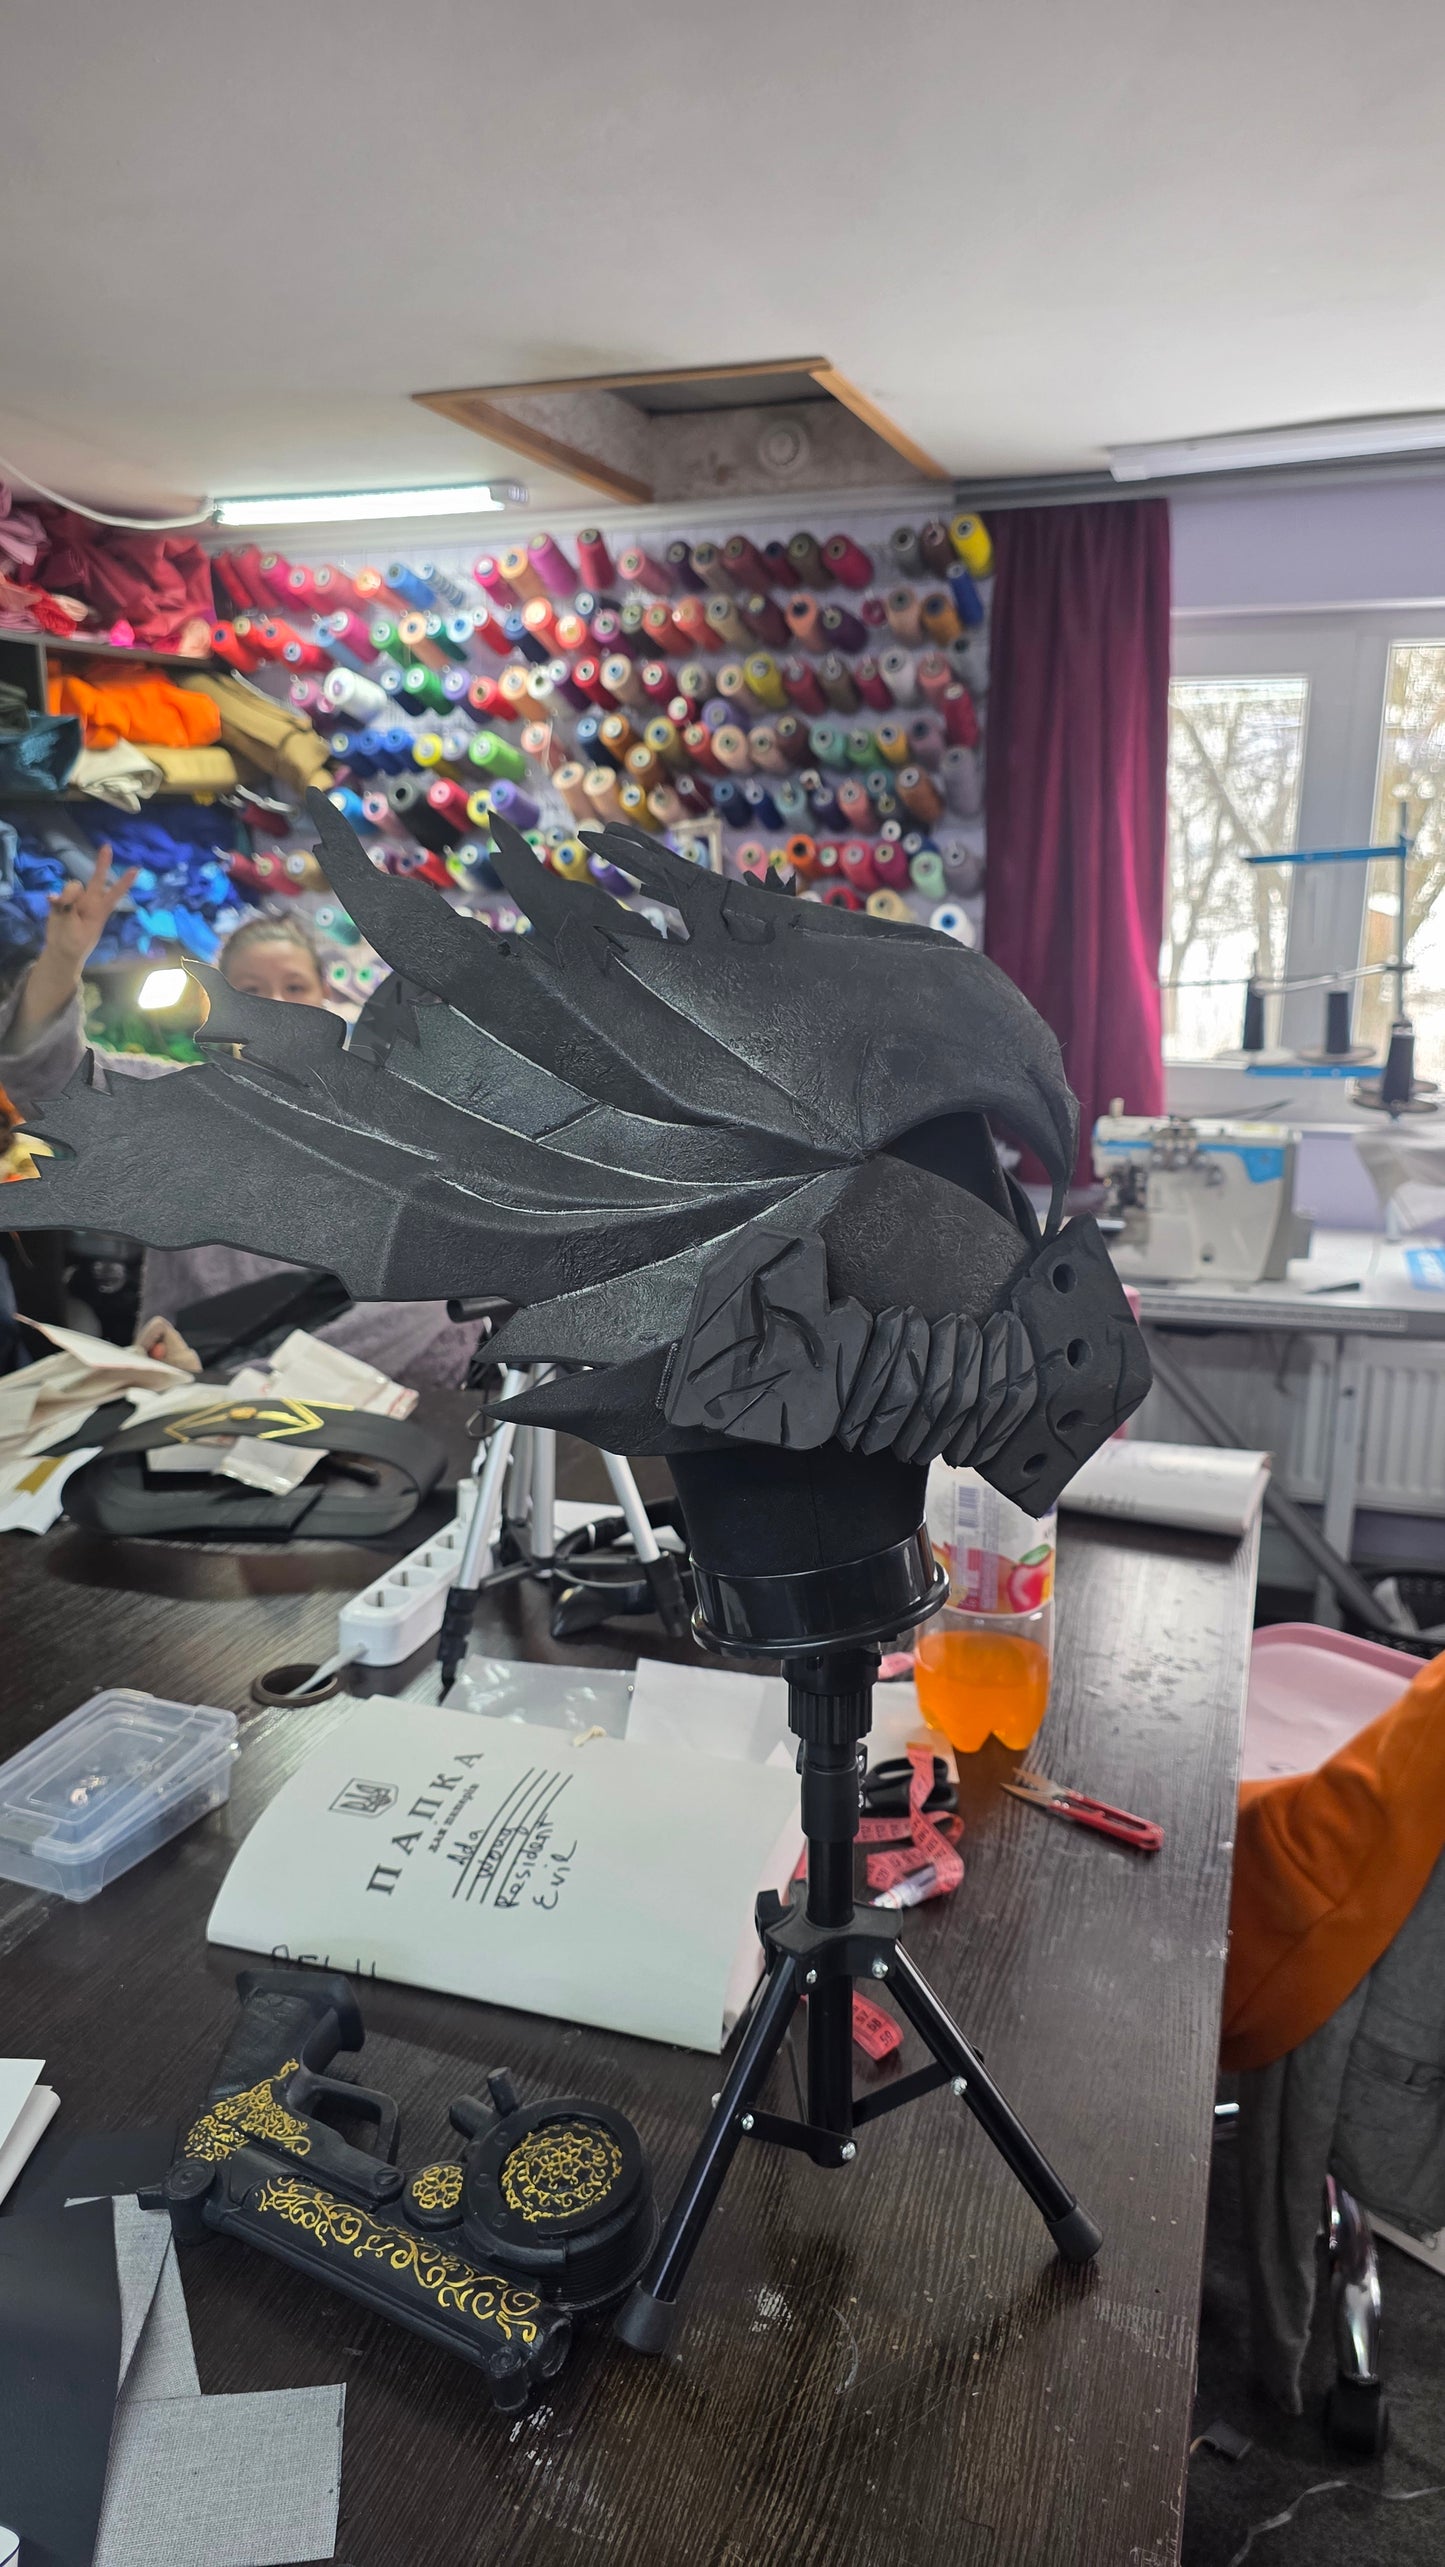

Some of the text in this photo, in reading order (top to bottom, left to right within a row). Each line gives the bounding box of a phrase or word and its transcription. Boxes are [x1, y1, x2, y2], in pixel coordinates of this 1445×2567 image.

[366, 1753, 484, 1895] ПАПКА
[446, 1828, 485, 1865] Ada
[493, 1812, 554, 1908] Resident
[532, 1839, 577, 1910] Evil
[880, 2030, 894, 2046] 59
